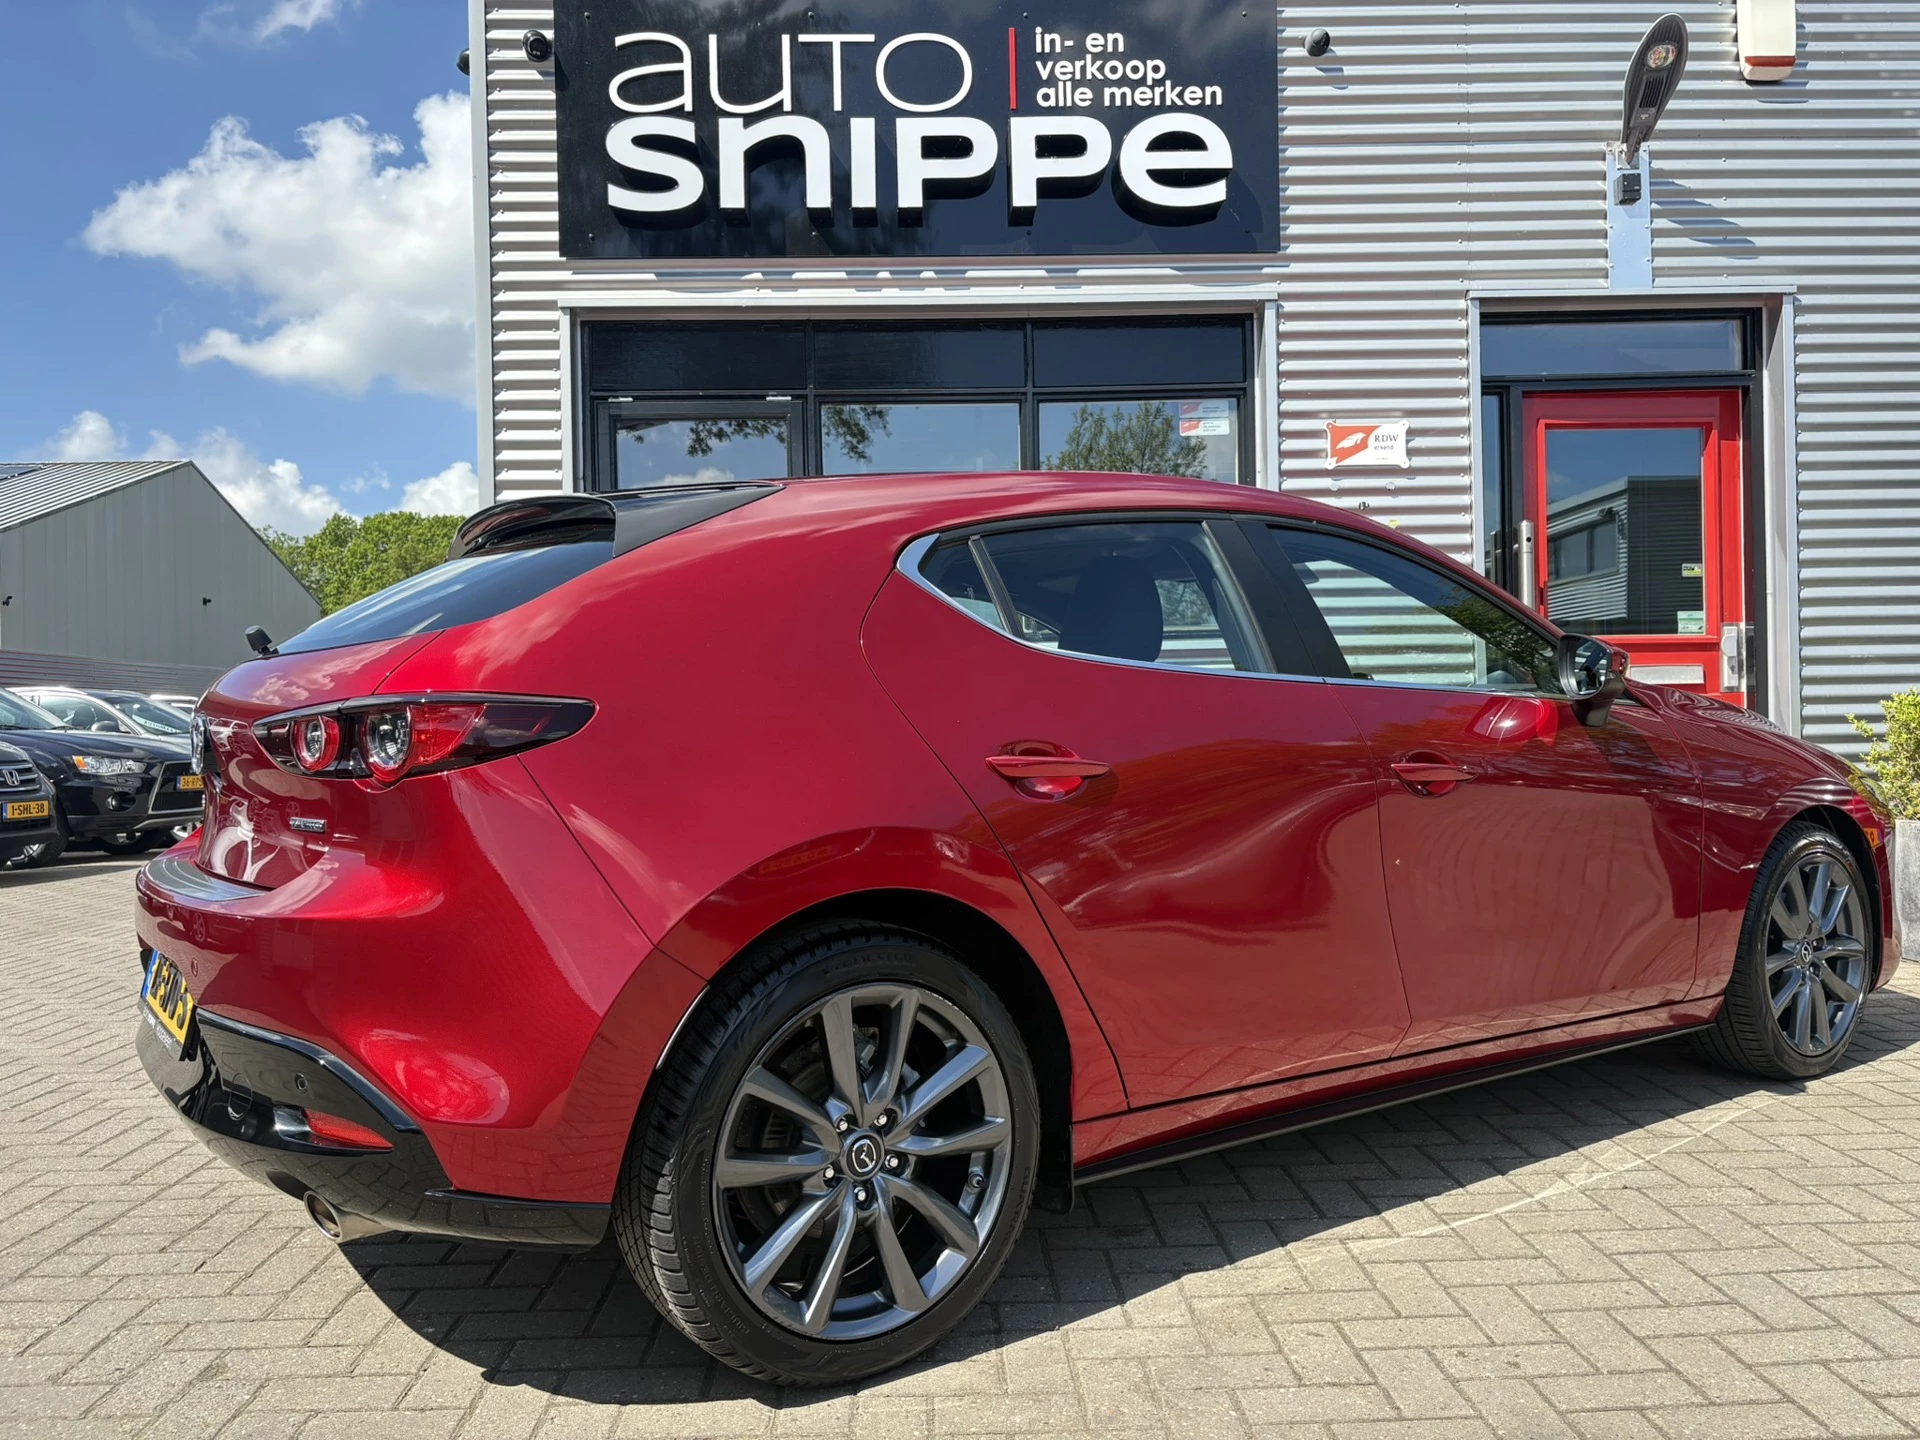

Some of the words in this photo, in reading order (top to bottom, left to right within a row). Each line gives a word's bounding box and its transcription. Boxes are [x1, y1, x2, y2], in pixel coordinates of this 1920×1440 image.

[1035, 26, 1074, 53] in-
[1085, 32, 1125, 53] en
[1035, 54, 1166, 86] verkoop
[1036, 81, 1094, 107] alle
[1103, 80, 1223, 107] merken
[1374, 434, 1399, 443] RDW
[11, 803, 45, 816] 1-SHL-38
